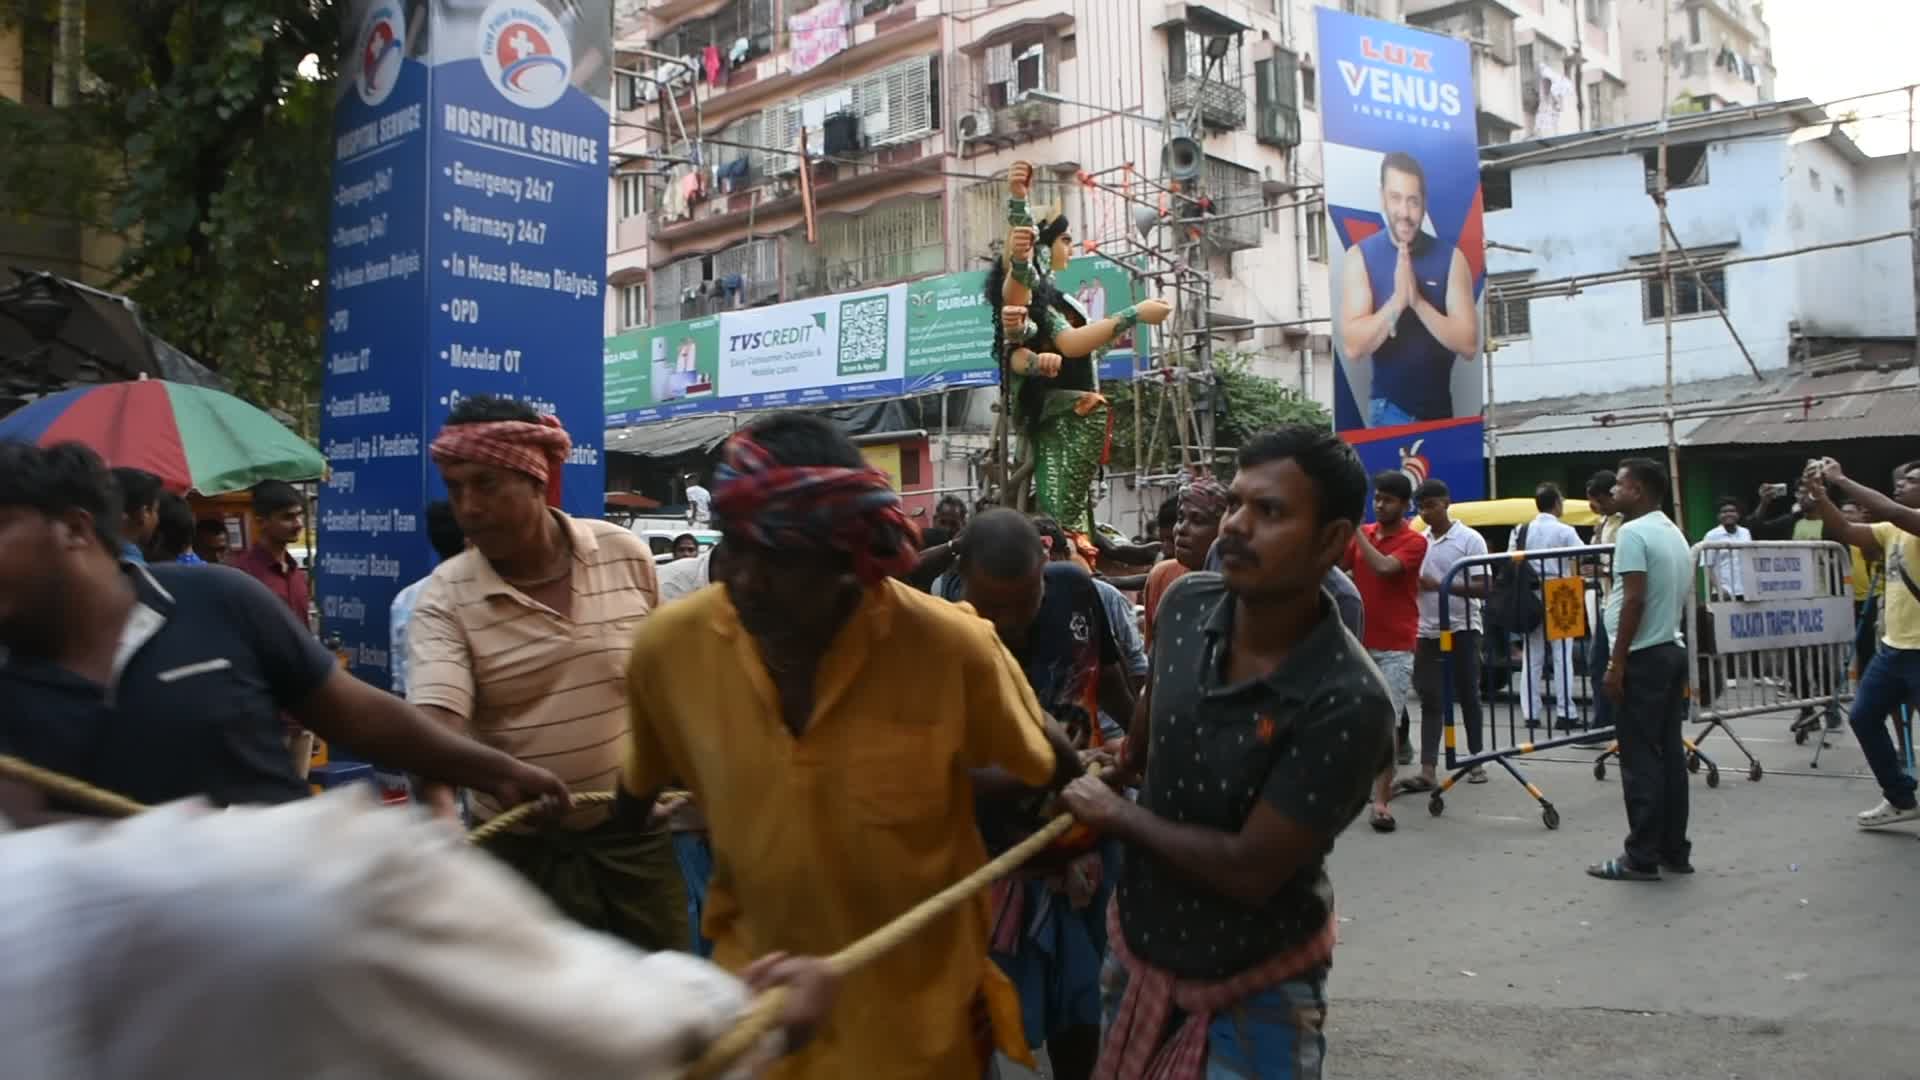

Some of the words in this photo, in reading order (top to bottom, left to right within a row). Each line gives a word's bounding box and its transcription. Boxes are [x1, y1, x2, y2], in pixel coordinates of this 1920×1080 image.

[1360, 36, 1434, 72] LUX
[1337, 60, 1461, 116] VENUS
[444, 103, 528, 148] HOSPITAL
[531, 126, 598, 164] SERVICE
[453, 161, 522, 203] Emergency
[525, 176, 554, 202] 24x7
[452, 206, 516, 245] Pharmacy
[517, 217, 547, 245] 24x7
[452, 254, 465, 272] In
[468, 255, 507, 283] House
[510, 261, 550, 289] Haemo
[553, 269, 598, 299] Dialysis
[451, 299, 479, 323] OPD
[450, 344, 502, 372] Modular
[504, 350, 522, 373] OT
[1766, 609, 1796, 636] TRAFFIC
[1797, 608, 1824, 633] POLICE
